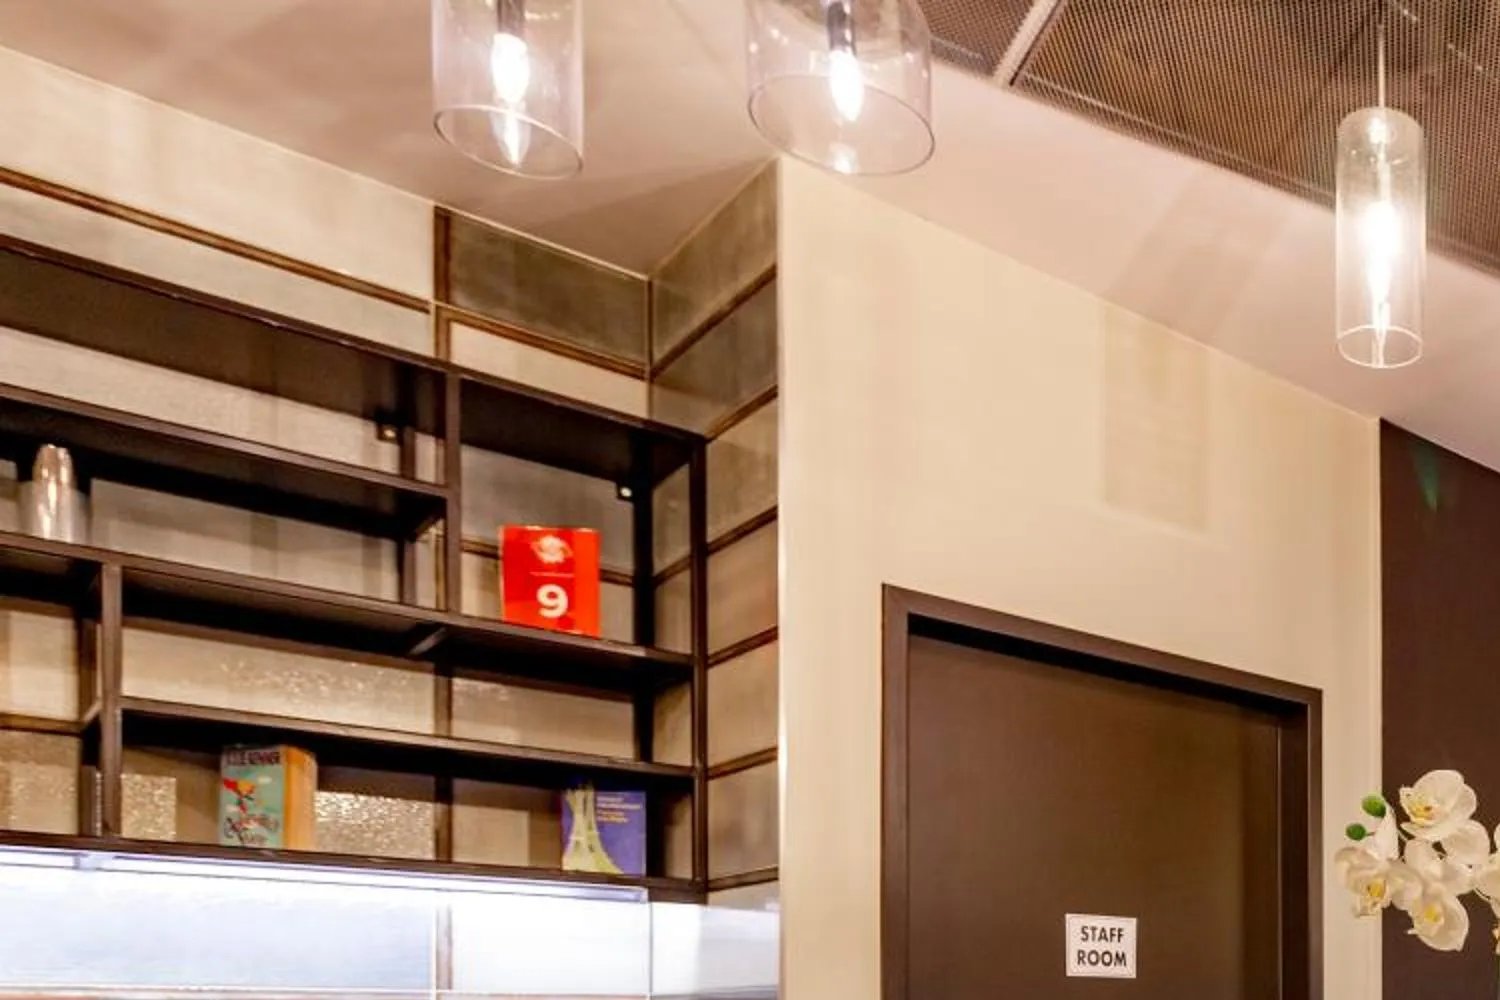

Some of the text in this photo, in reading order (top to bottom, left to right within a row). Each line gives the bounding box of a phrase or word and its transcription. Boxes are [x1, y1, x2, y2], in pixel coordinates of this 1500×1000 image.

[537, 584, 569, 618] 9
[1080, 925, 1124, 943] STAFF
[1077, 949, 1127, 967] ROOM
